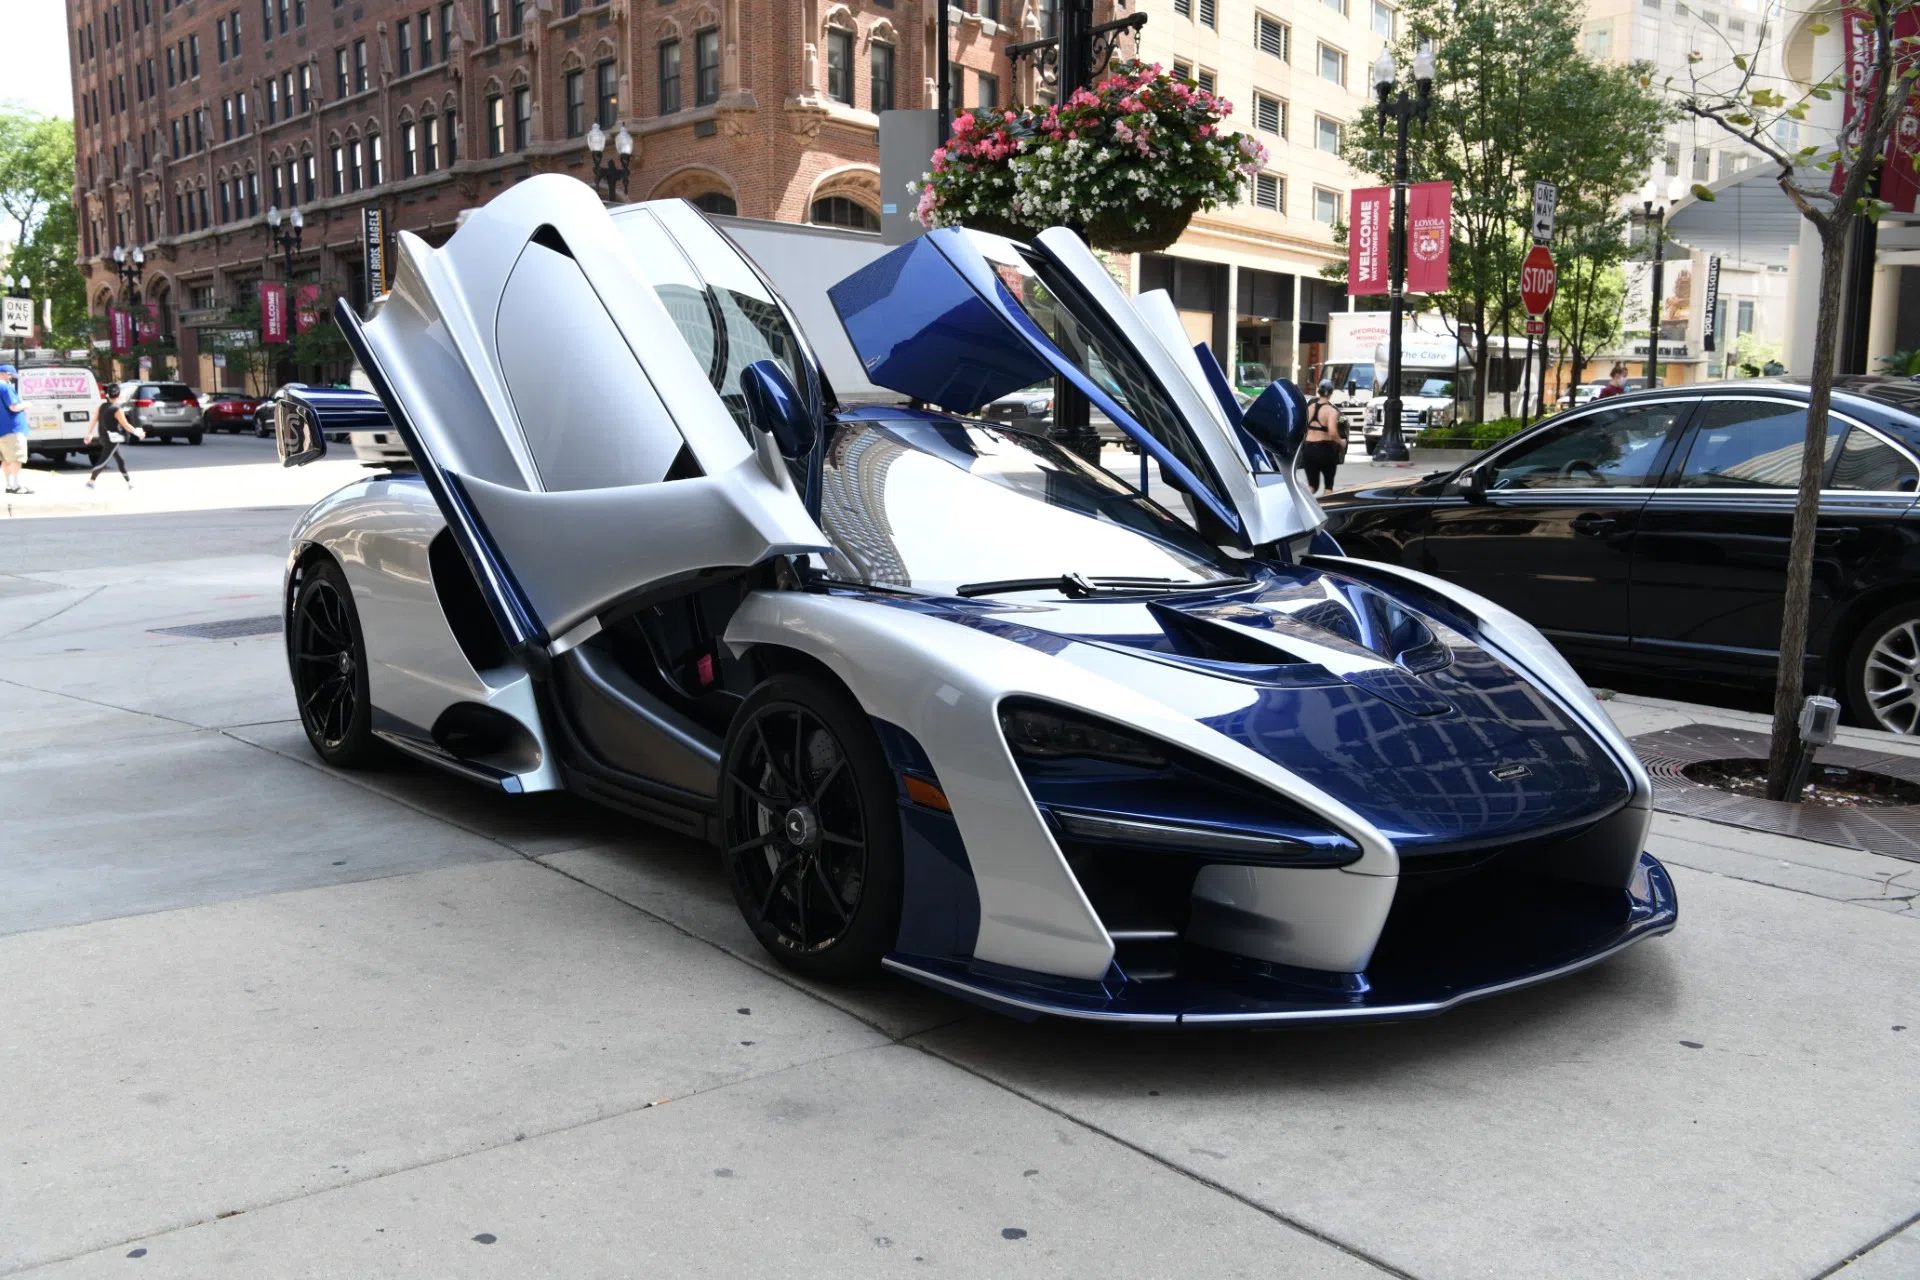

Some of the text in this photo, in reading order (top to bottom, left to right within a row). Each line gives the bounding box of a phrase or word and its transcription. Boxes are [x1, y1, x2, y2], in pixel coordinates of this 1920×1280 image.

[1537, 187, 1553, 203] ONE
[1372, 200, 1380, 230] CAMPUS
[1536, 202, 1553, 218] WAY
[368, 210, 380, 244] BAGELS
[1414, 218, 1445, 227] LOYOLA
[1359, 200, 1372, 281] WELCOME
[371, 272, 383, 300] STEIN
[1523, 266, 1554, 294] STOP
[1704, 256, 1718, 336] NORDSTROM rack
[7, 301, 29, 313] ONE
[267, 291, 277, 335] WELCOME
[7, 312, 29, 321] WAY
[1349, 327, 1391, 336] AFFORDABL
[1421, 351, 1447, 360] Clare
[23, 377, 88, 395] SHAVITZ
